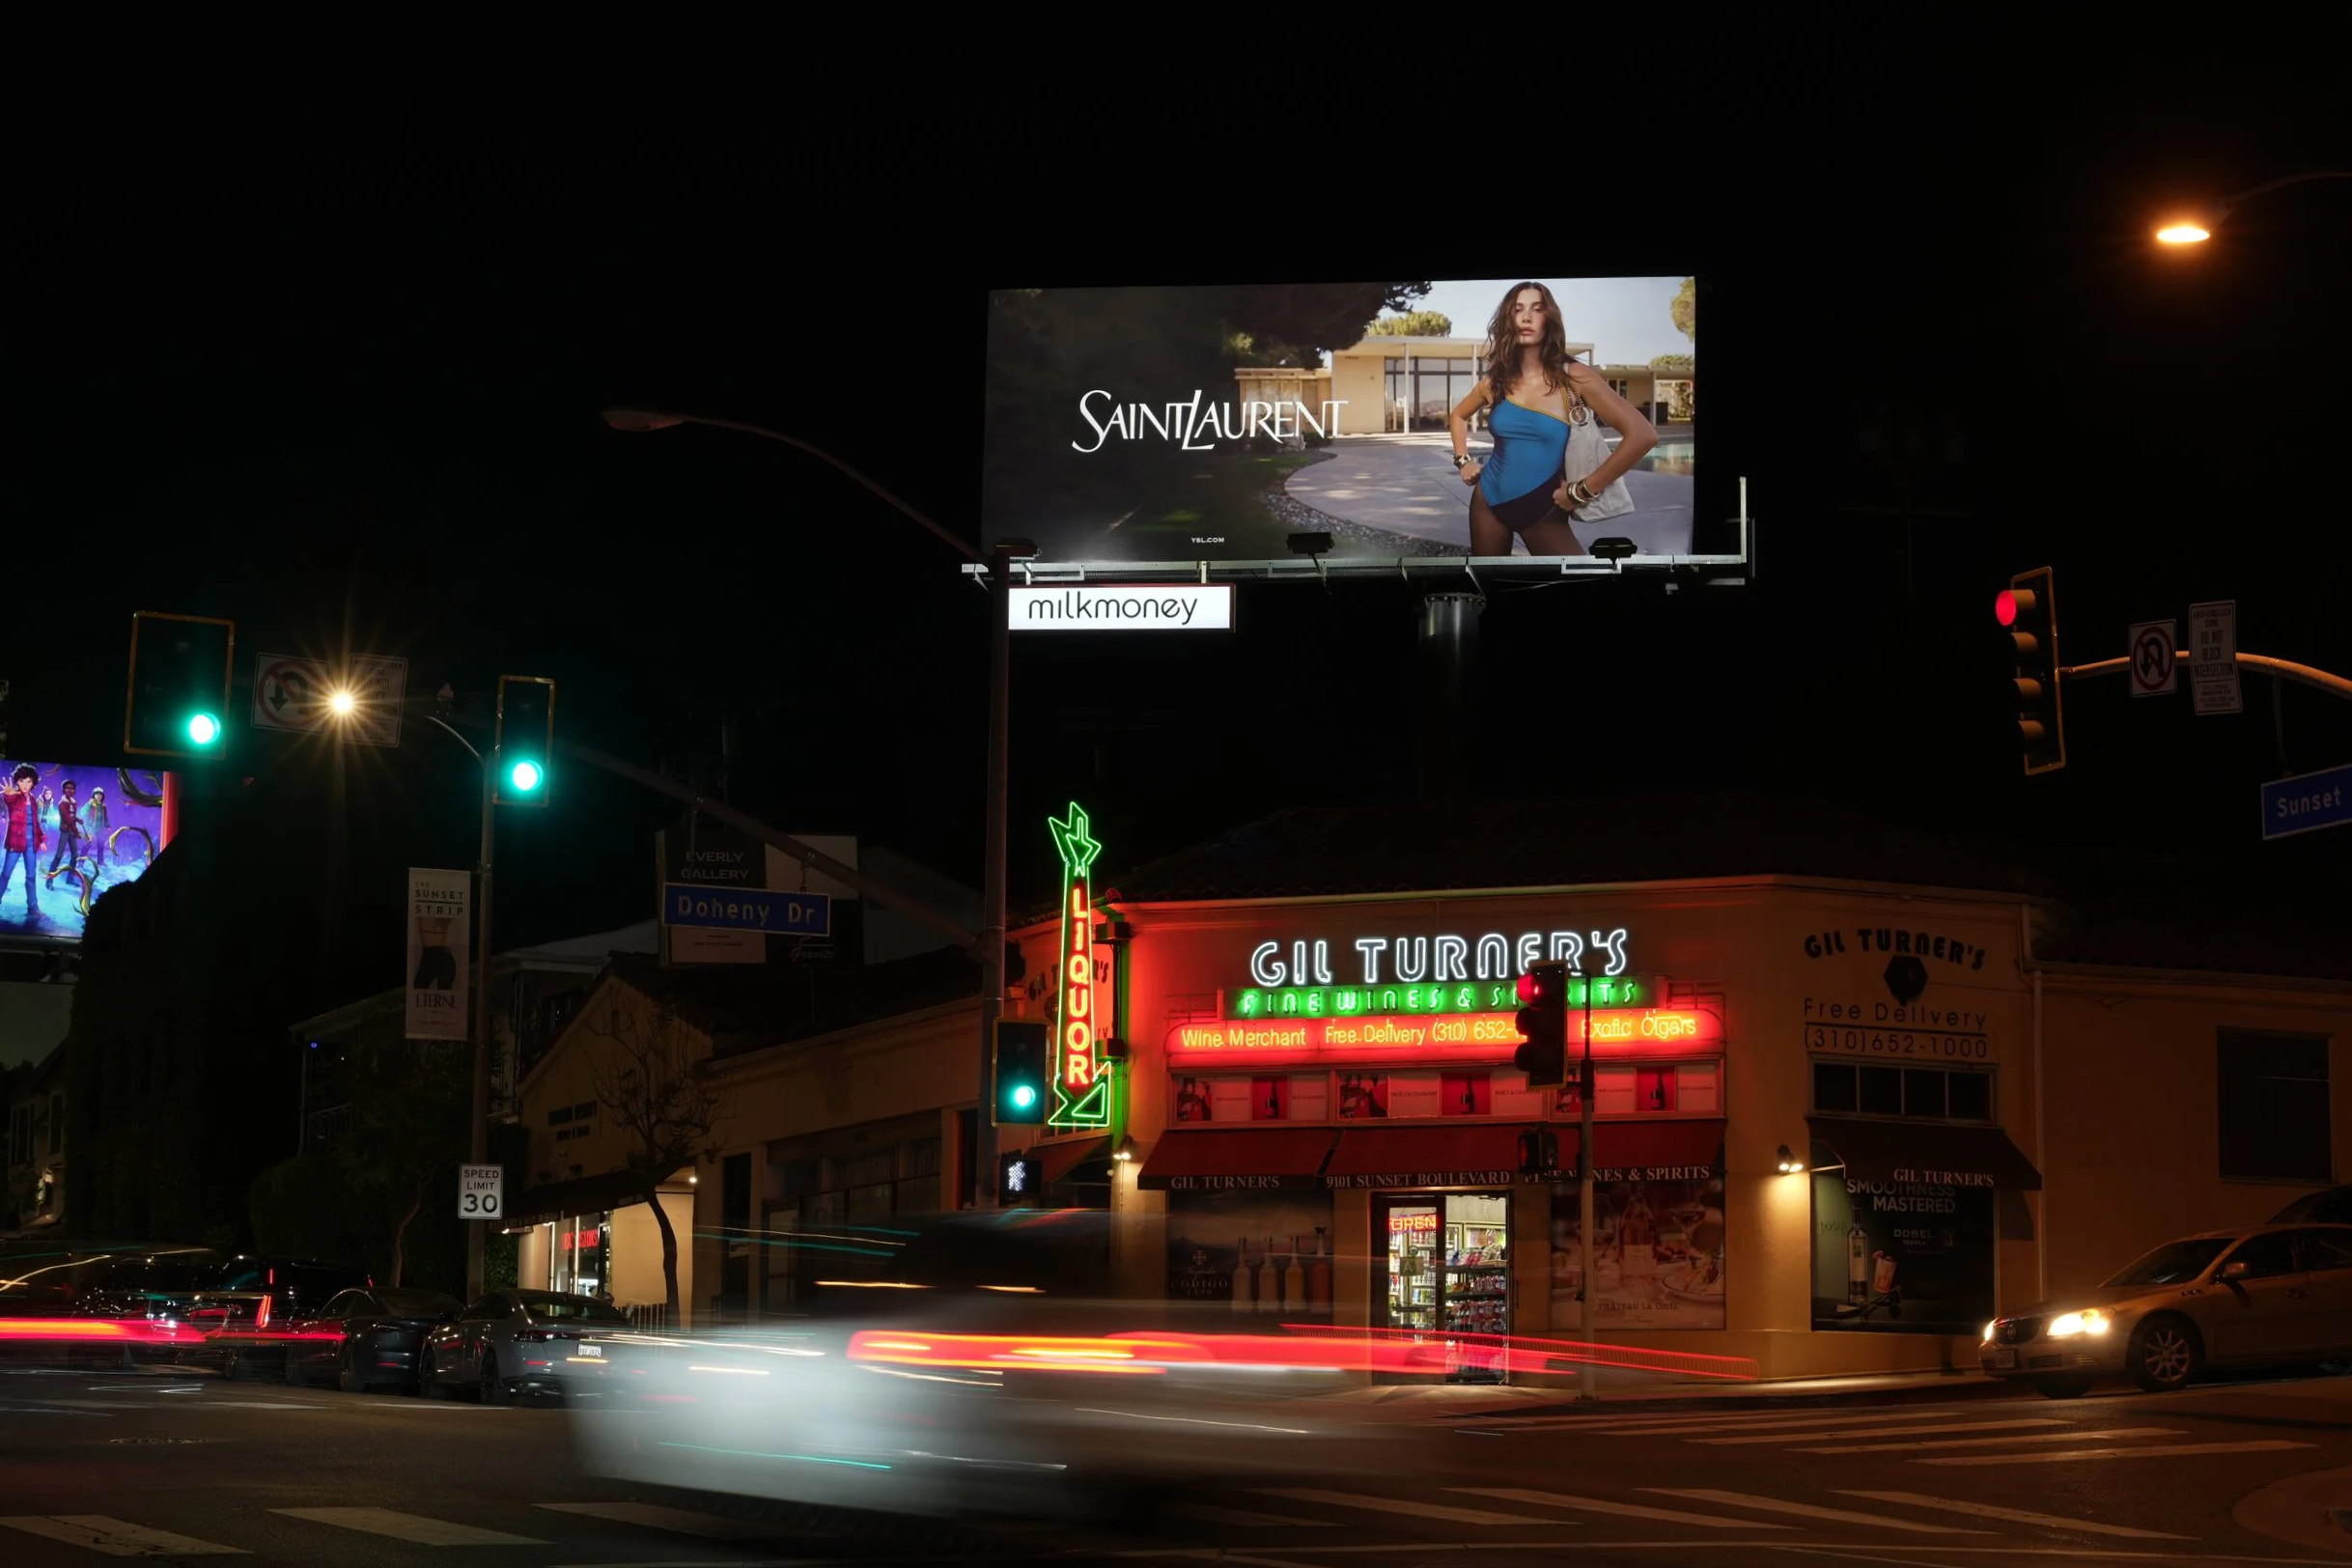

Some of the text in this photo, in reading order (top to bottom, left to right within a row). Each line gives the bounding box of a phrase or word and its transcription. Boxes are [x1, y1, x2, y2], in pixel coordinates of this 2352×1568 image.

[1028, 591, 1198, 626] milkmoney
[2277, 785, 2341, 819] Sunset
[686, 851, 744, 863] EVERLY
[681, 868, 749, 881] GALLERY
[415, 889, 463, 900] SUNSET
[415, 905, 463, 915] STRIP
[678, 894, 815, 927] Doheny Dr
[1251, 928, 1626, 987] GIL TURNER'S
[1804, 928, 1985, 970] GIL TURNER'S
[1067, 888, 1090, 1084] LIQUOR
[1242, 991, 1322, 1015] FINE
[1336, 987, 1442, 1012] WINES
[1457, 986, 1472, 1009] &
[1804, 997, 1986, 1032] Free Delivery
[1182, 1028, 1223, 1048] Wine
[1229, 1026, 1306, 1047] Merchant
[1326, 1025, 1357, 1045] Free
[1363, 1021, 1426, 1046] Delivery
[1432, 1020, 1467, 1042] (310)
[1582, 1018, 1632, 1038] Exotic
[1640, 1015, 1696, 1039] Cigars
[1805, 1026, 1987, 1059] (310)652-1000
[464, 1169, 499, 1179] SPEED
[1170, 1174, 1280, 1190] GIL TURNER'S
[1326, 1171, 1511, 1189] 9101 SUNSET BOULEVARD
[1628, 1167, 1641, 1182] &
[1646, 1165, 1710, 1181] SPIRITS
[1893, 1168, 1995, 1188] GIL TURNER'S
[466, 1182, 494, 1190] LIMIT
[1846, 1178, 1956, 1197] SMOOTHNESS
[463, 1193, 498, 1213] 30
[1873, 1196, 1956, 1214] MASTERED
[1390, 1216, 1437, 1231] OPEN
[1893, 1228, 1935, 1239] DOBEL
